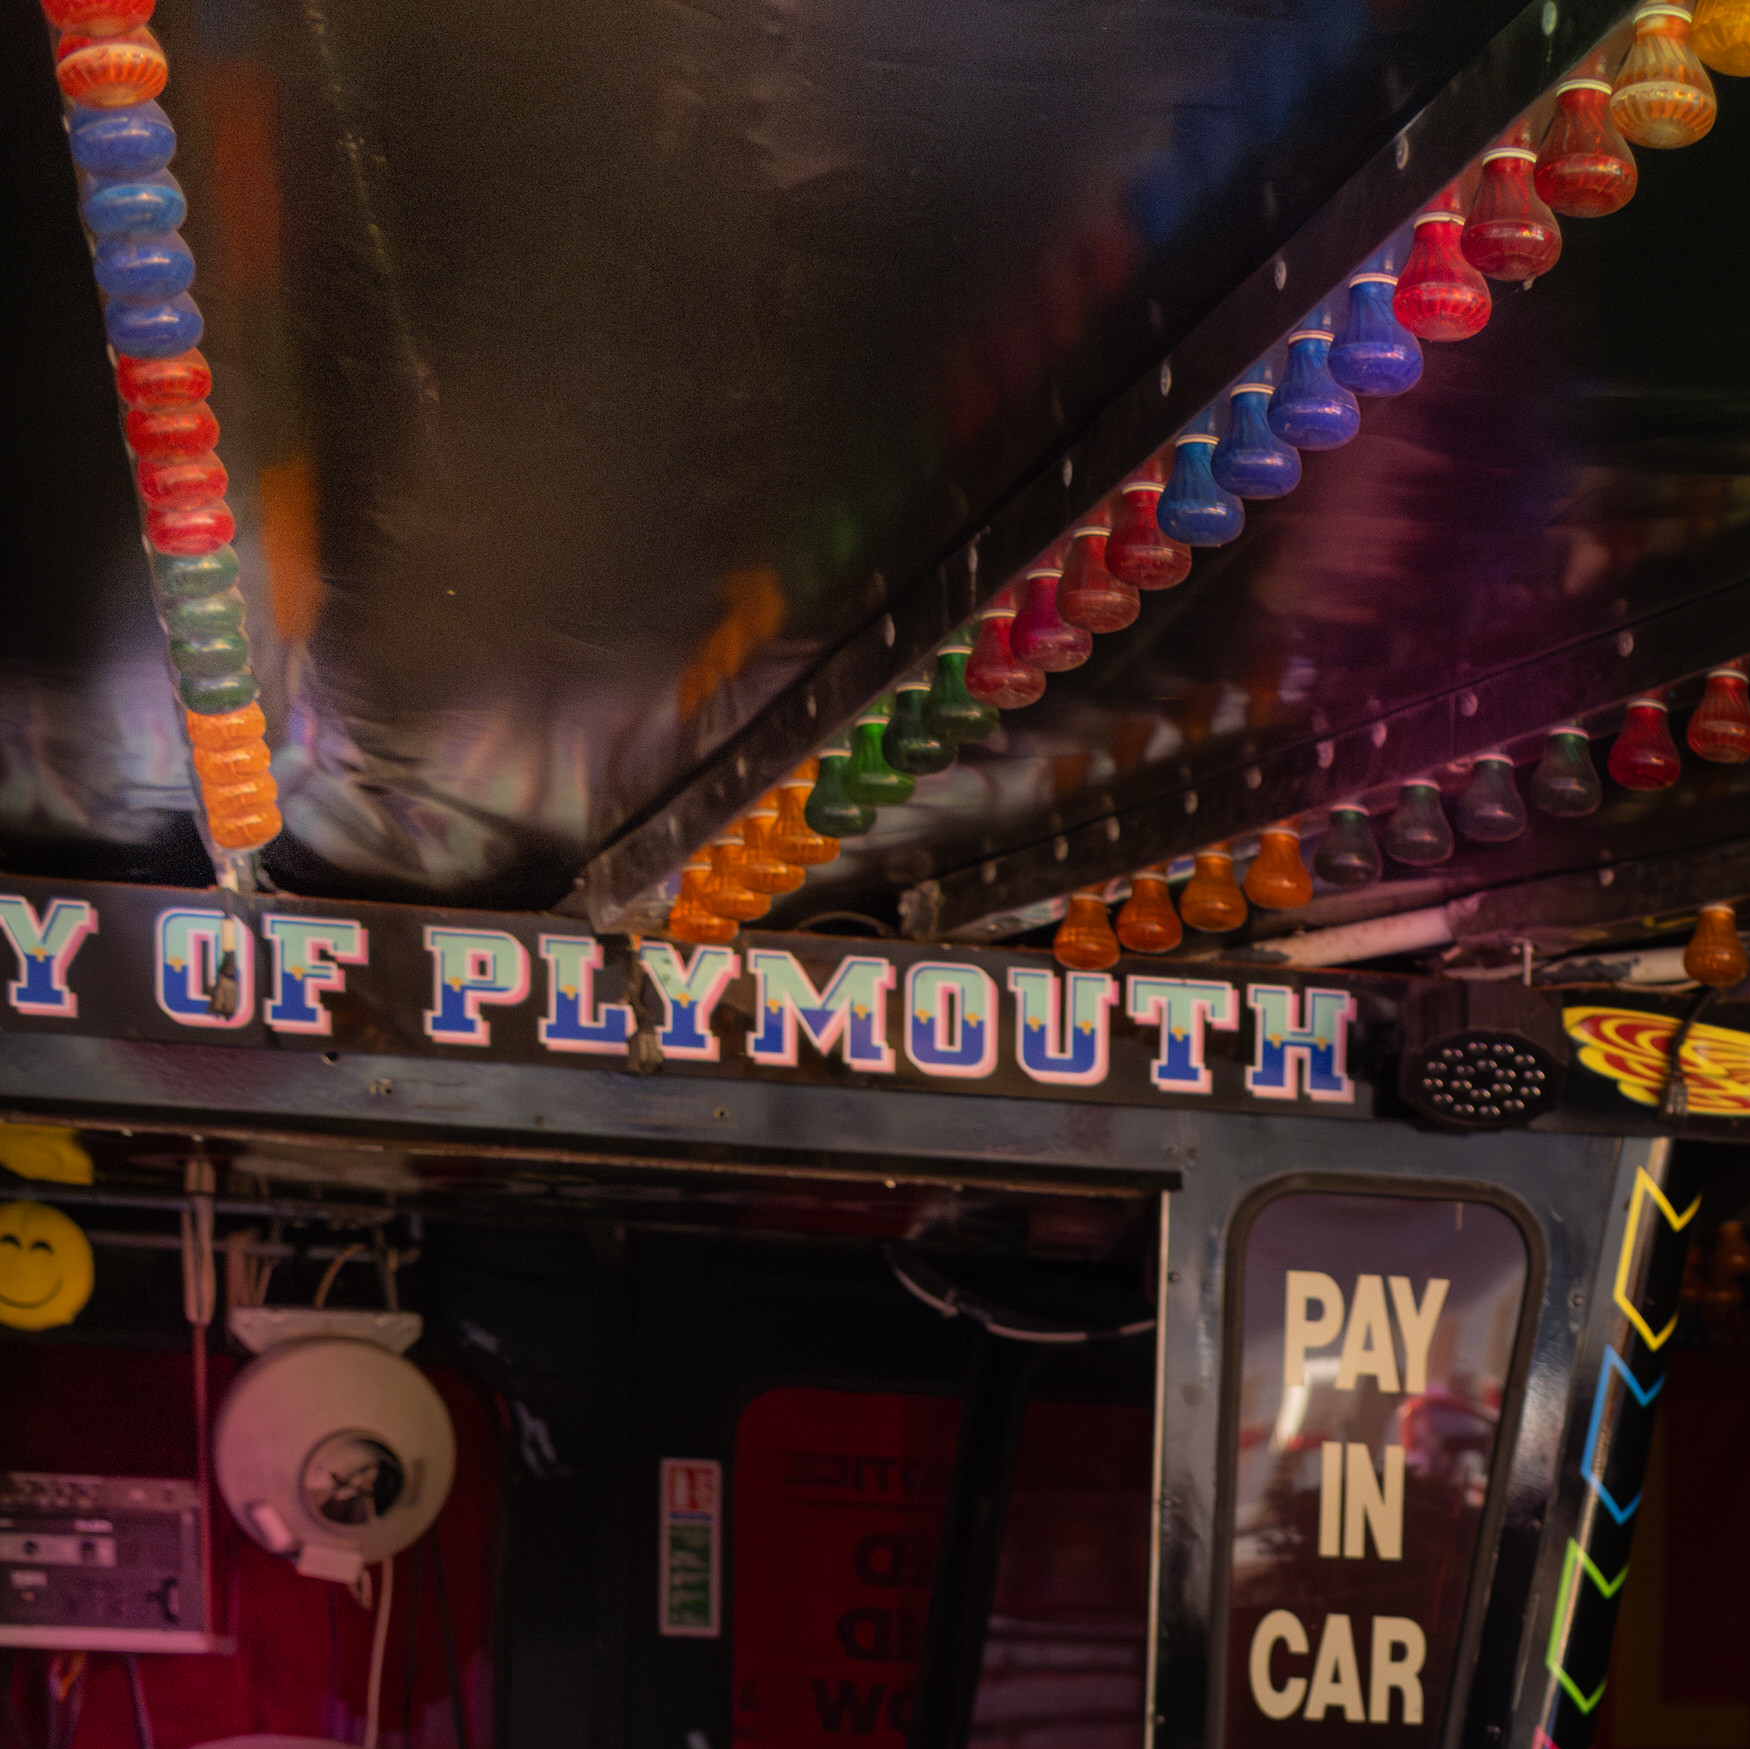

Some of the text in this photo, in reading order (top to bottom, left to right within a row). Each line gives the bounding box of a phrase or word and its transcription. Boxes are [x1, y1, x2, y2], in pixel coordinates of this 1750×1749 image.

[0, 894, 1358, 1105] Y OF PLYMOUTH
[1284, 1269, 1451, 1395] PAY
[1318, 1441, 1405, 1561] IN
[1249, 1609, 1427, 1726] CAR
